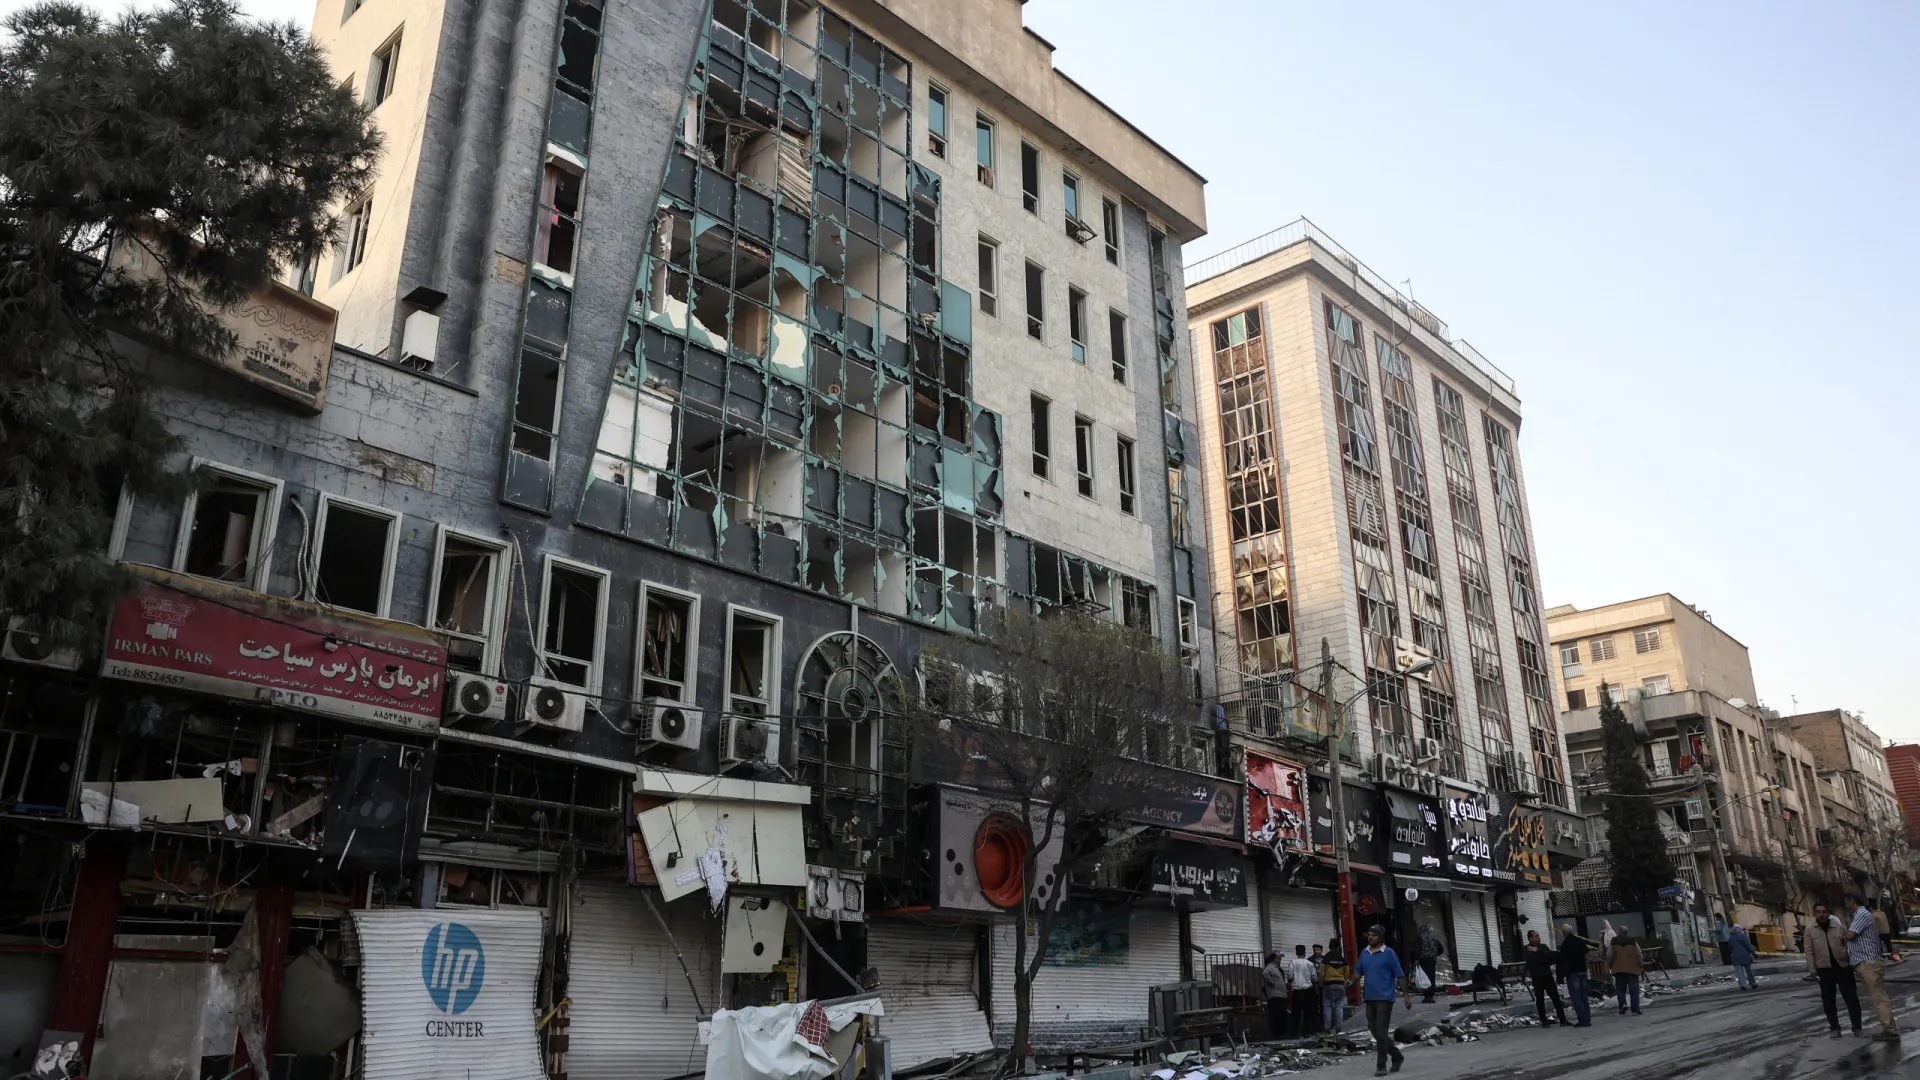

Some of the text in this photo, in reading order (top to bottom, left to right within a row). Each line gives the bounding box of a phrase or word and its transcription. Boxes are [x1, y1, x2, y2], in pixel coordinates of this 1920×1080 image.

[113, 638, 213, 666] IRMAN PARS
[378, 641, 410, 655] خدمات
[412, 649, 439, 662] شرکت
[111, 665, 185, 685] Tel: 88524557
[238, 638, 440, 699] ایرمان پارس سیاحت
[370, 694, 383, 702] ایران
[373, 710, 413, 724] ۸۸۵۲۴۵۵۷
[1141, 805, 1183, 823] AGENCY
[1396, 822, 1427, 847] خانواده
[430, 922, 479, 1015] hp
[426, 1020, 484, 1038] CENTER
